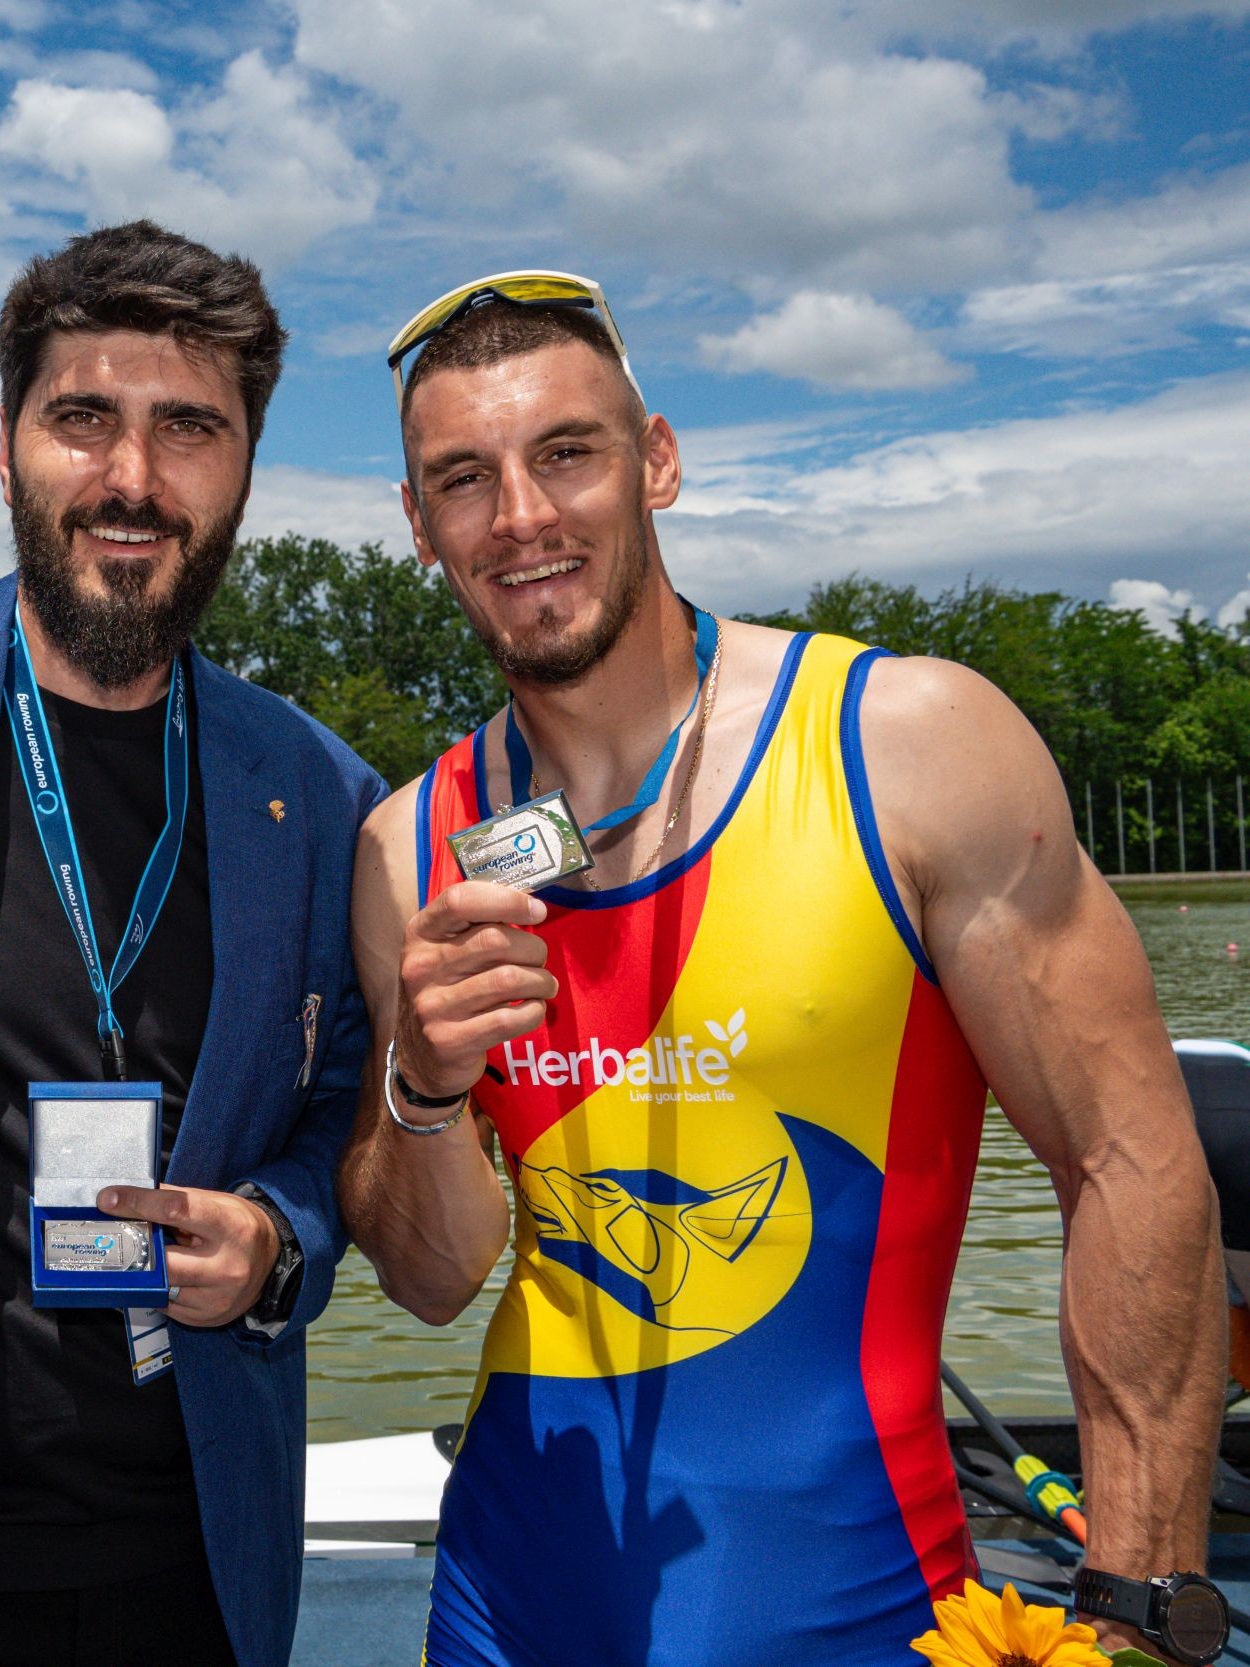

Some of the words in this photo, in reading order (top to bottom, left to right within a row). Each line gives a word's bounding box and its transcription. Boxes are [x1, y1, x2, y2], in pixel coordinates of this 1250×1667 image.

[16, 693, 34, 731] rowing
[26, 732, 48, 789] european
[472, 851, 518, 874] european
[499, 853, 534, 872] rowing
[60, 864, 78, 907] rowing
[72, 907, 95, 966] european
[503, 1034, 730, 1087] Herbalife
[629, 1089, 654, 1102] Live
[655, 1091, 682, 1105] your
[684, 1089, 711, 1102] best
[714, 1089, 735, 1102] life
